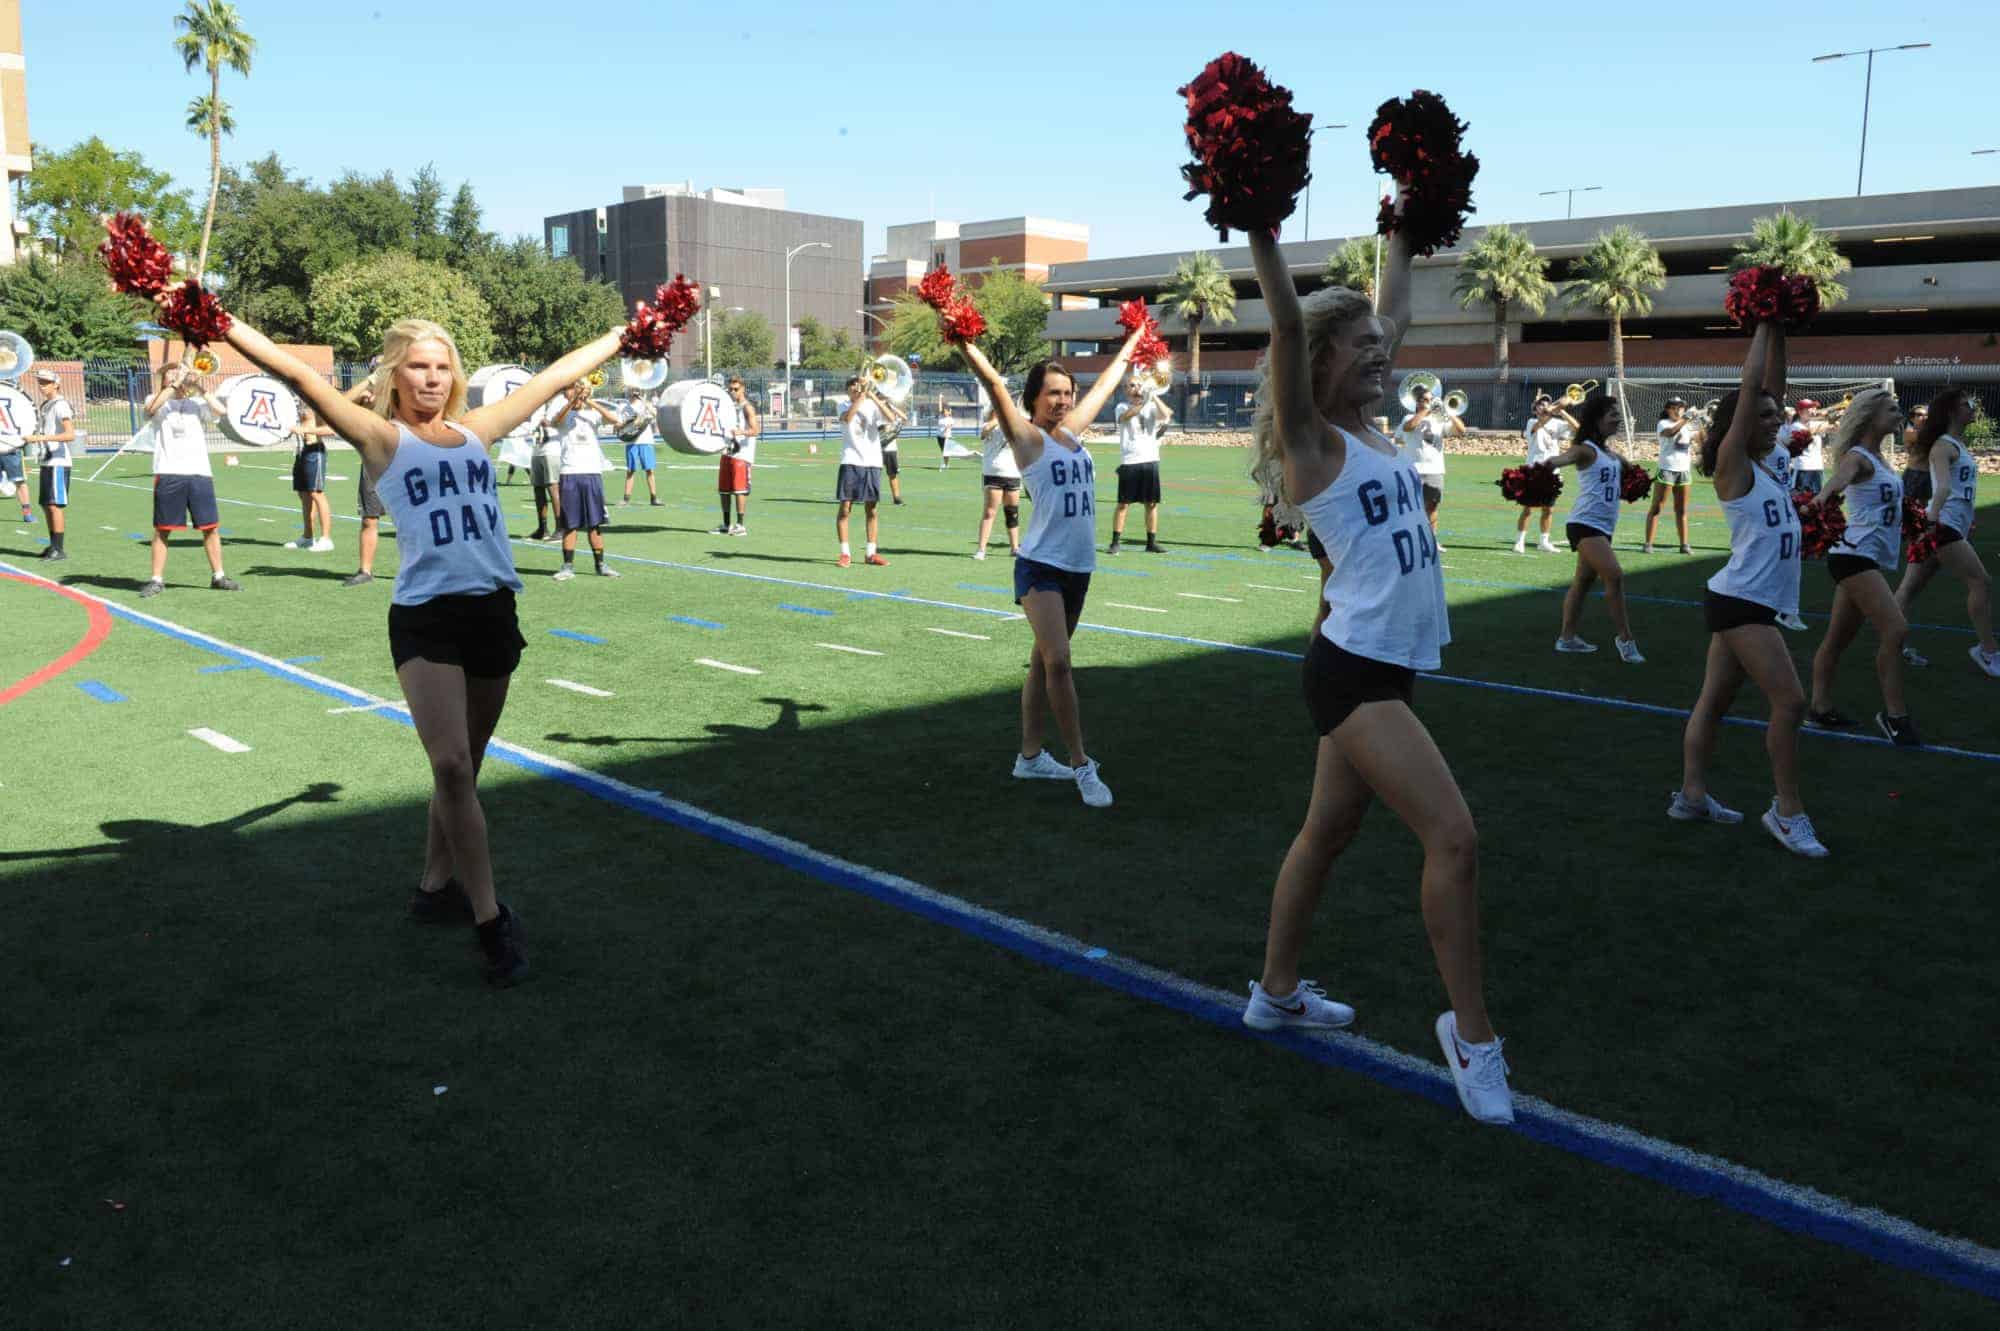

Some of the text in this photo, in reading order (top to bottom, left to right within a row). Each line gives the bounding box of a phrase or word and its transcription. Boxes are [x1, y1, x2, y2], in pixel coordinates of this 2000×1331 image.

[1904, 355, 1949, 366] Entrance
[240, 388, 281, 430] A
[690, 395, 725, 437] A
[404, 459, 497, 506] GAM
[1064, 491, 1095, 518] DA
[1392, 524, 1437, 576] DA
